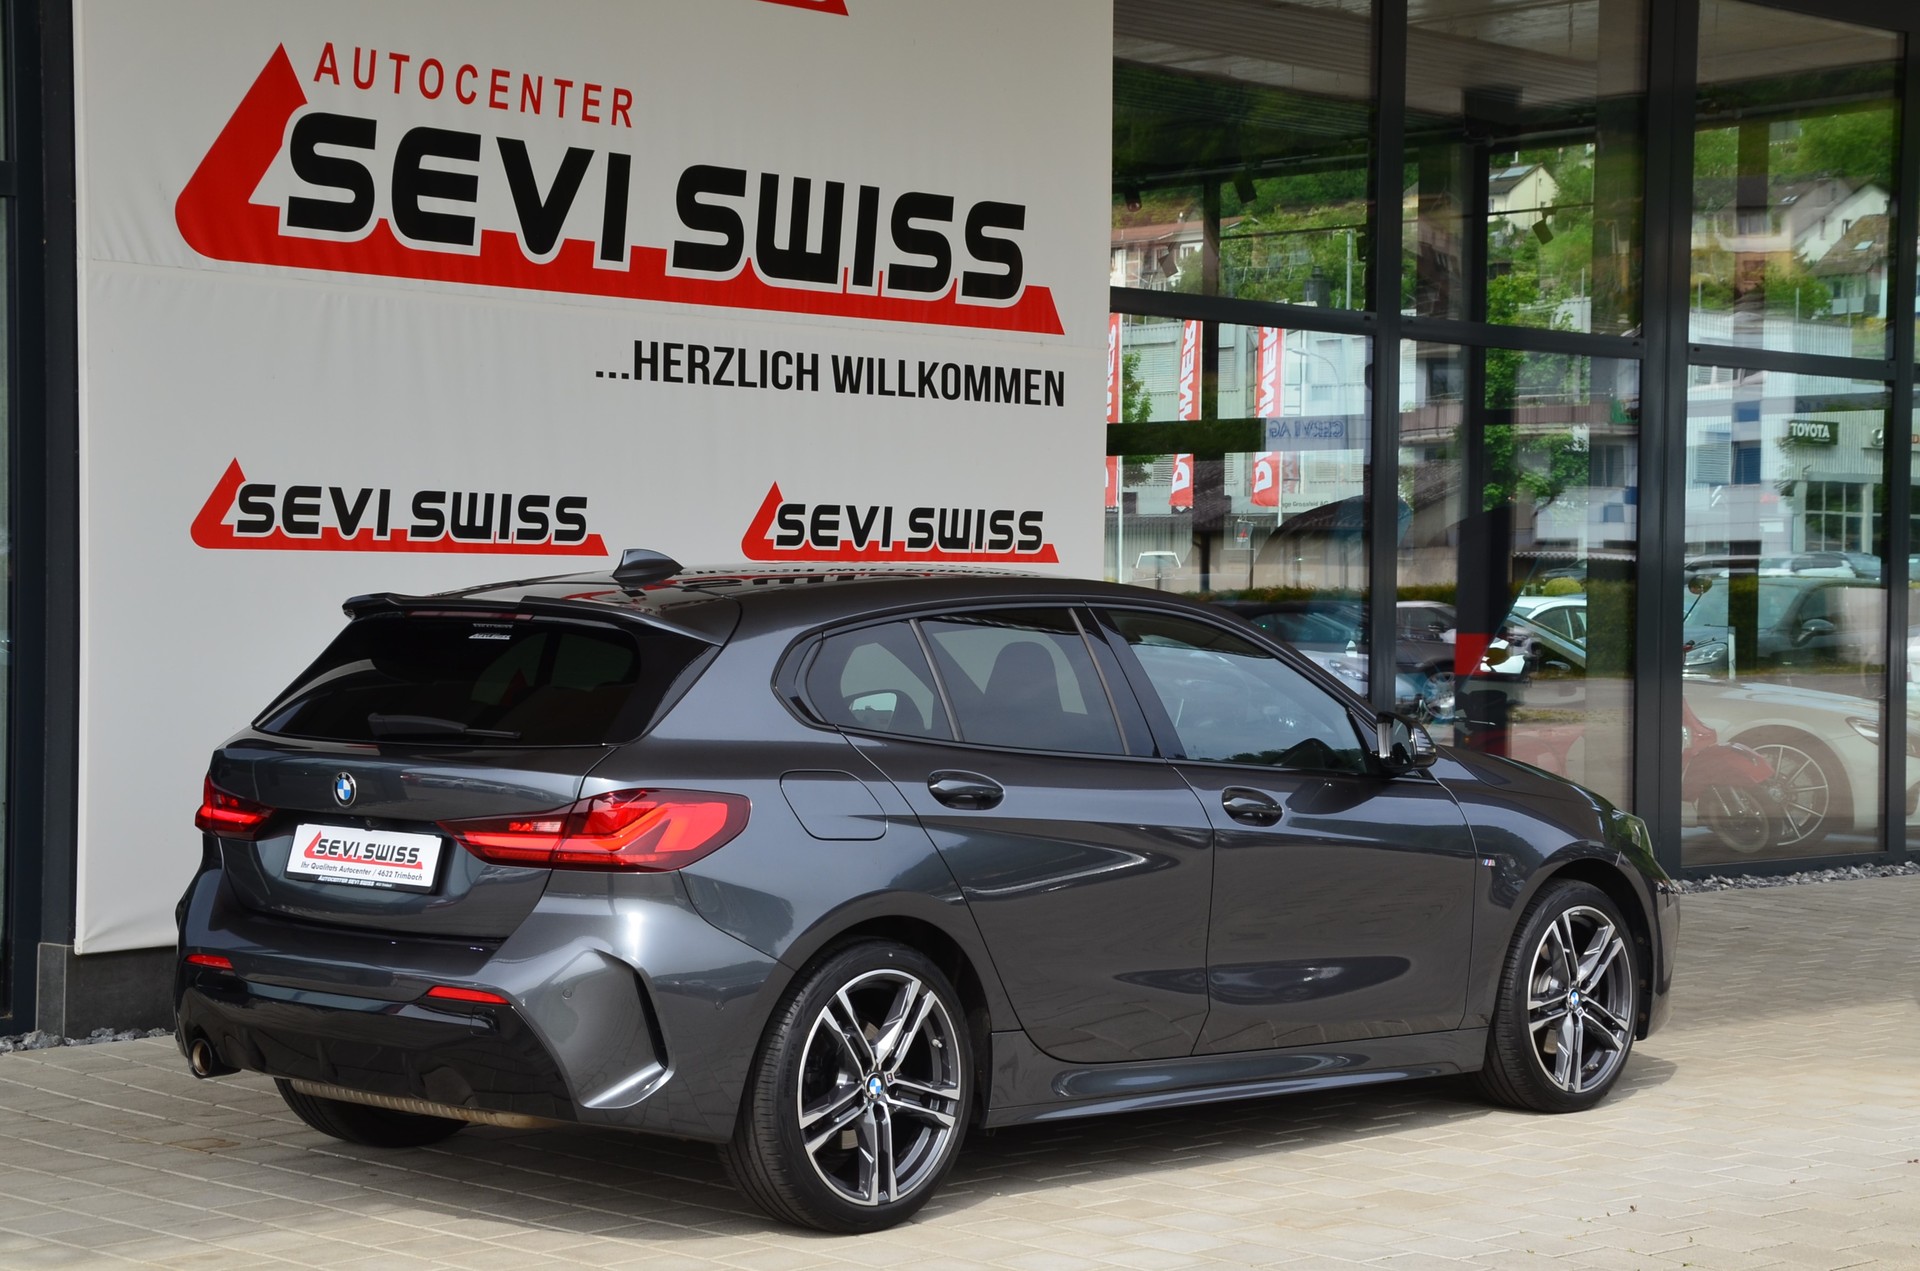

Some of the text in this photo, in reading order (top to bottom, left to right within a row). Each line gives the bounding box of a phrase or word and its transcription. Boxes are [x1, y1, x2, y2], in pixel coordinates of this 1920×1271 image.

[314, 43, 633, 128] AUTOCENTER
[287, 113, 1026, 299] SEVI SWISS
[832, 355, 1064, 406] WILLKOMMEN
[1790, 423, 1830, 438] TOYOTA
[237, 484, 587, 541] SEVI SWISS
[777, 504, 1043, 550] SEVI SWISS
[300, 861, 310, 869] Ihr
[338, 865, 372, 876] Autocenter
[377, 869, 393, 878] 4632
[394, 871, 423, 881] Trimbach
[316, 838, 420, 864] SEVI SWISS
